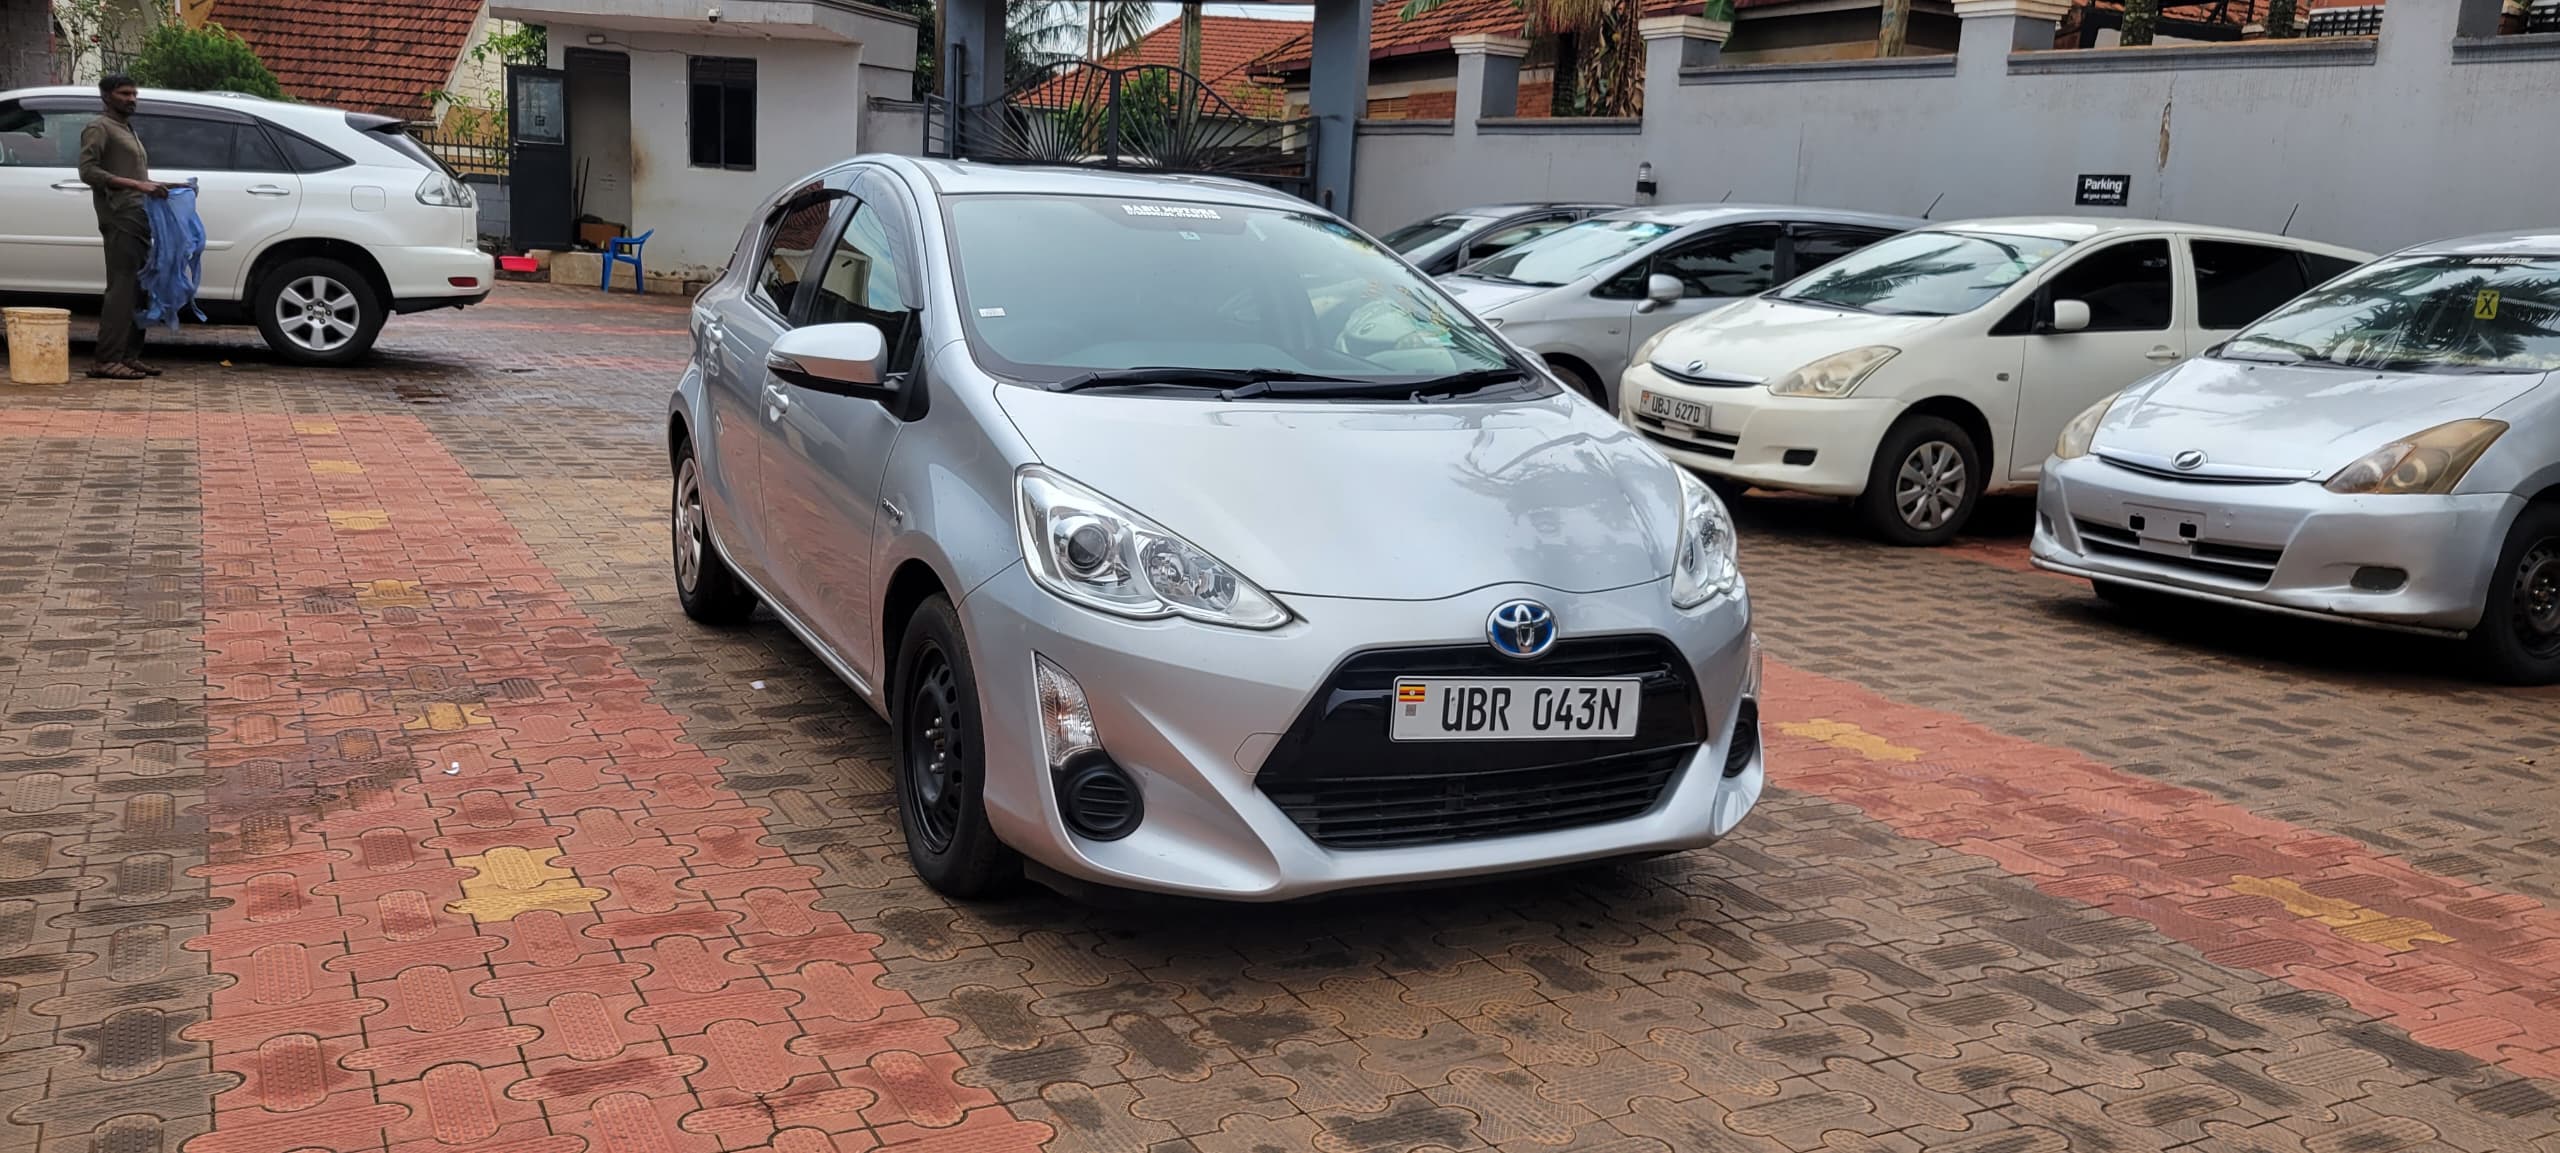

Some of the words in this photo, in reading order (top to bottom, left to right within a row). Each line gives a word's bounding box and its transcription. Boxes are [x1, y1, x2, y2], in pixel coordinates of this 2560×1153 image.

[2084, 178, 2123, 193] Parking
[2479, 292, 2497, 315] X
[1651, 396, 1671, 415] UBJ
[1675, 402, 1701, 423] 627D
[1441, 687, 1512, 732] UBR
[1532, 687, 1622, 731] 043N
